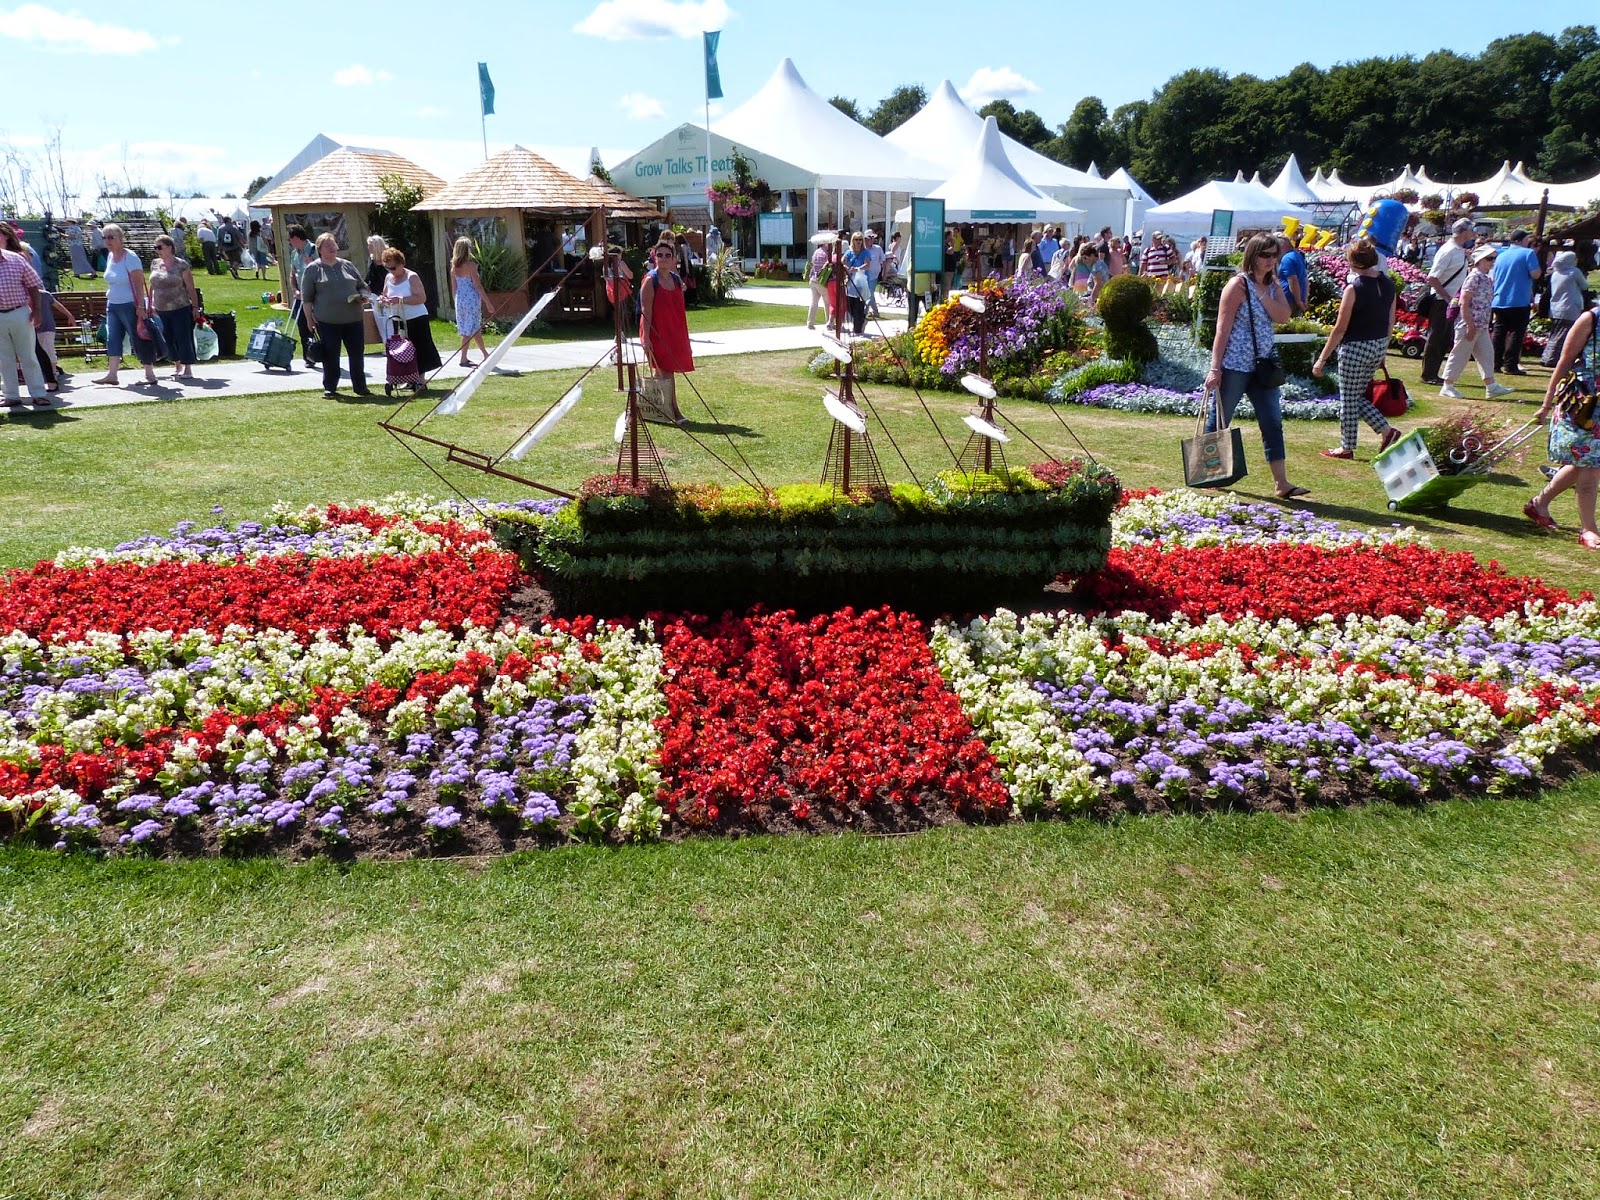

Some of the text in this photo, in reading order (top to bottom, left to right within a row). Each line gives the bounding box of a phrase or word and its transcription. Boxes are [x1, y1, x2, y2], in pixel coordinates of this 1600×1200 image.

[635, 155, 736, 177] Grow Talks Theatr
